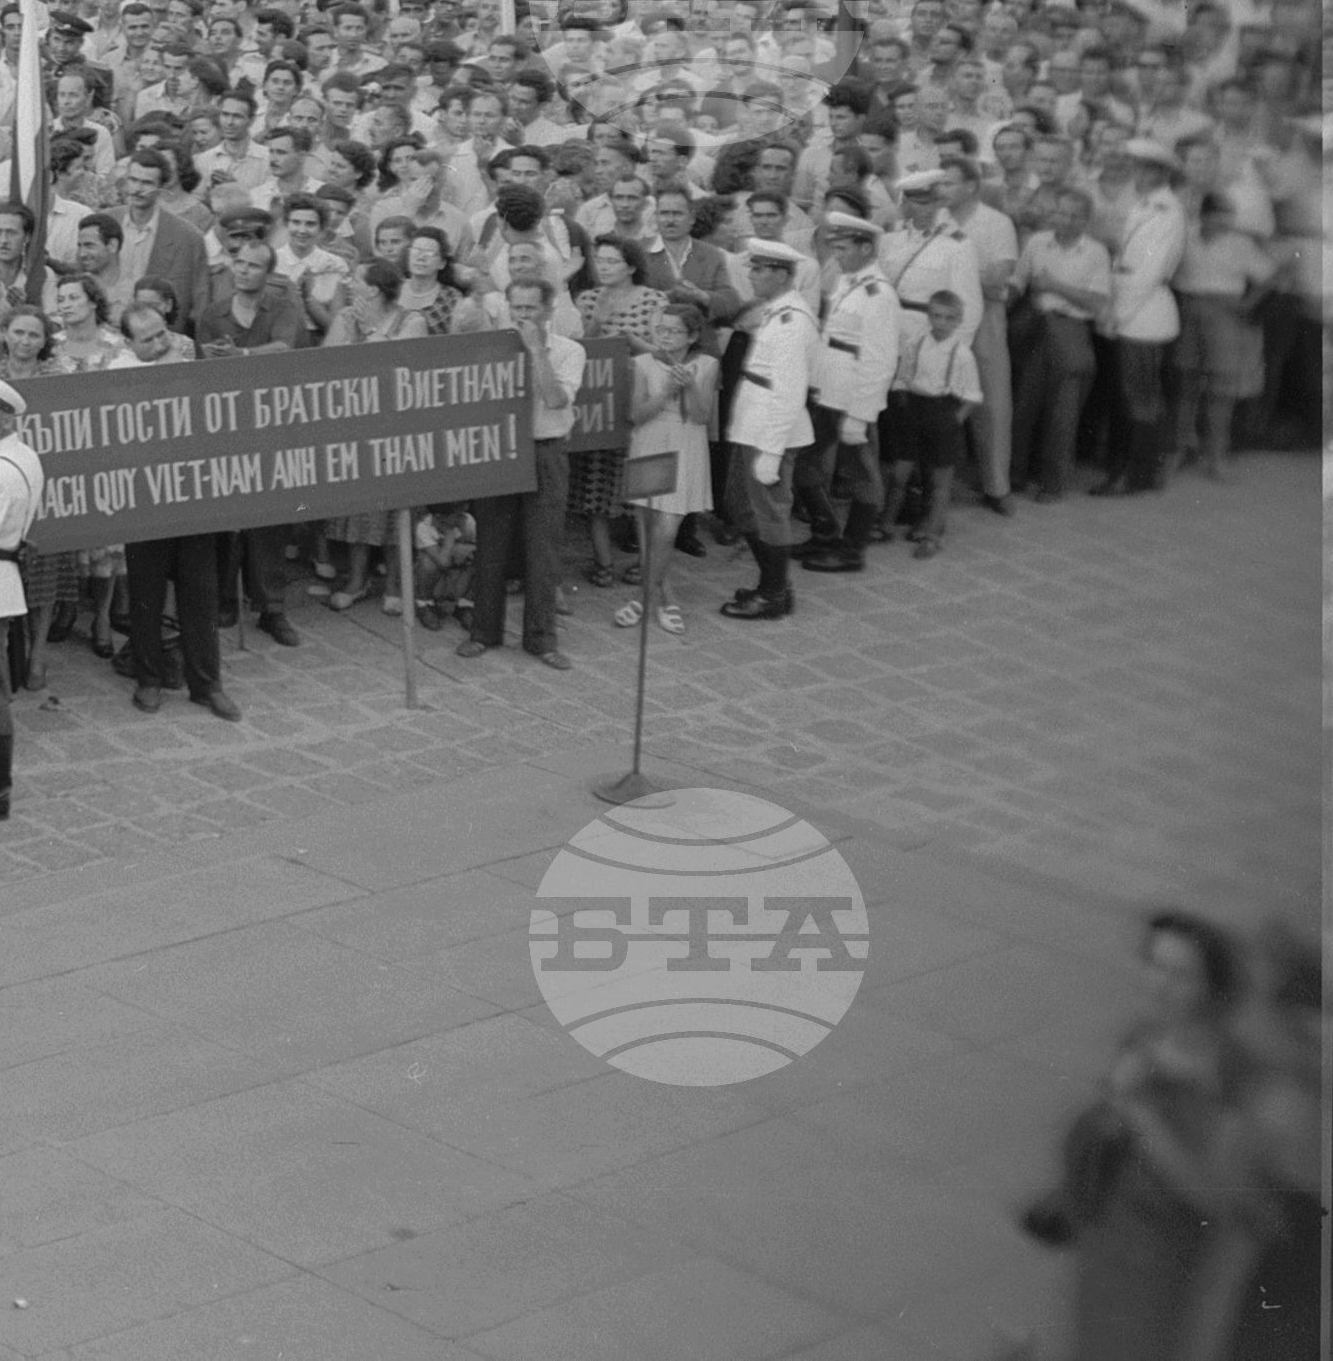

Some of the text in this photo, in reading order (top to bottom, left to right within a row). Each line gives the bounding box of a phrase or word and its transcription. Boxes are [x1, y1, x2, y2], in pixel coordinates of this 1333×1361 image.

[16, 407, 94, 455] КЪПИ
[99, 396, 193, 447] ГОСТИ
[204, 390, 243, 434] ОТ
[253, 375, 381, 429] БРАТСКИ
[93, 468, 137, 517] QUY
[144, 452, 264, 506] VIET-NAM
[270, 445, 318, 491] ANH
[326, 440, 360, 483] EM
[368, 431, 436, 477] THAN
